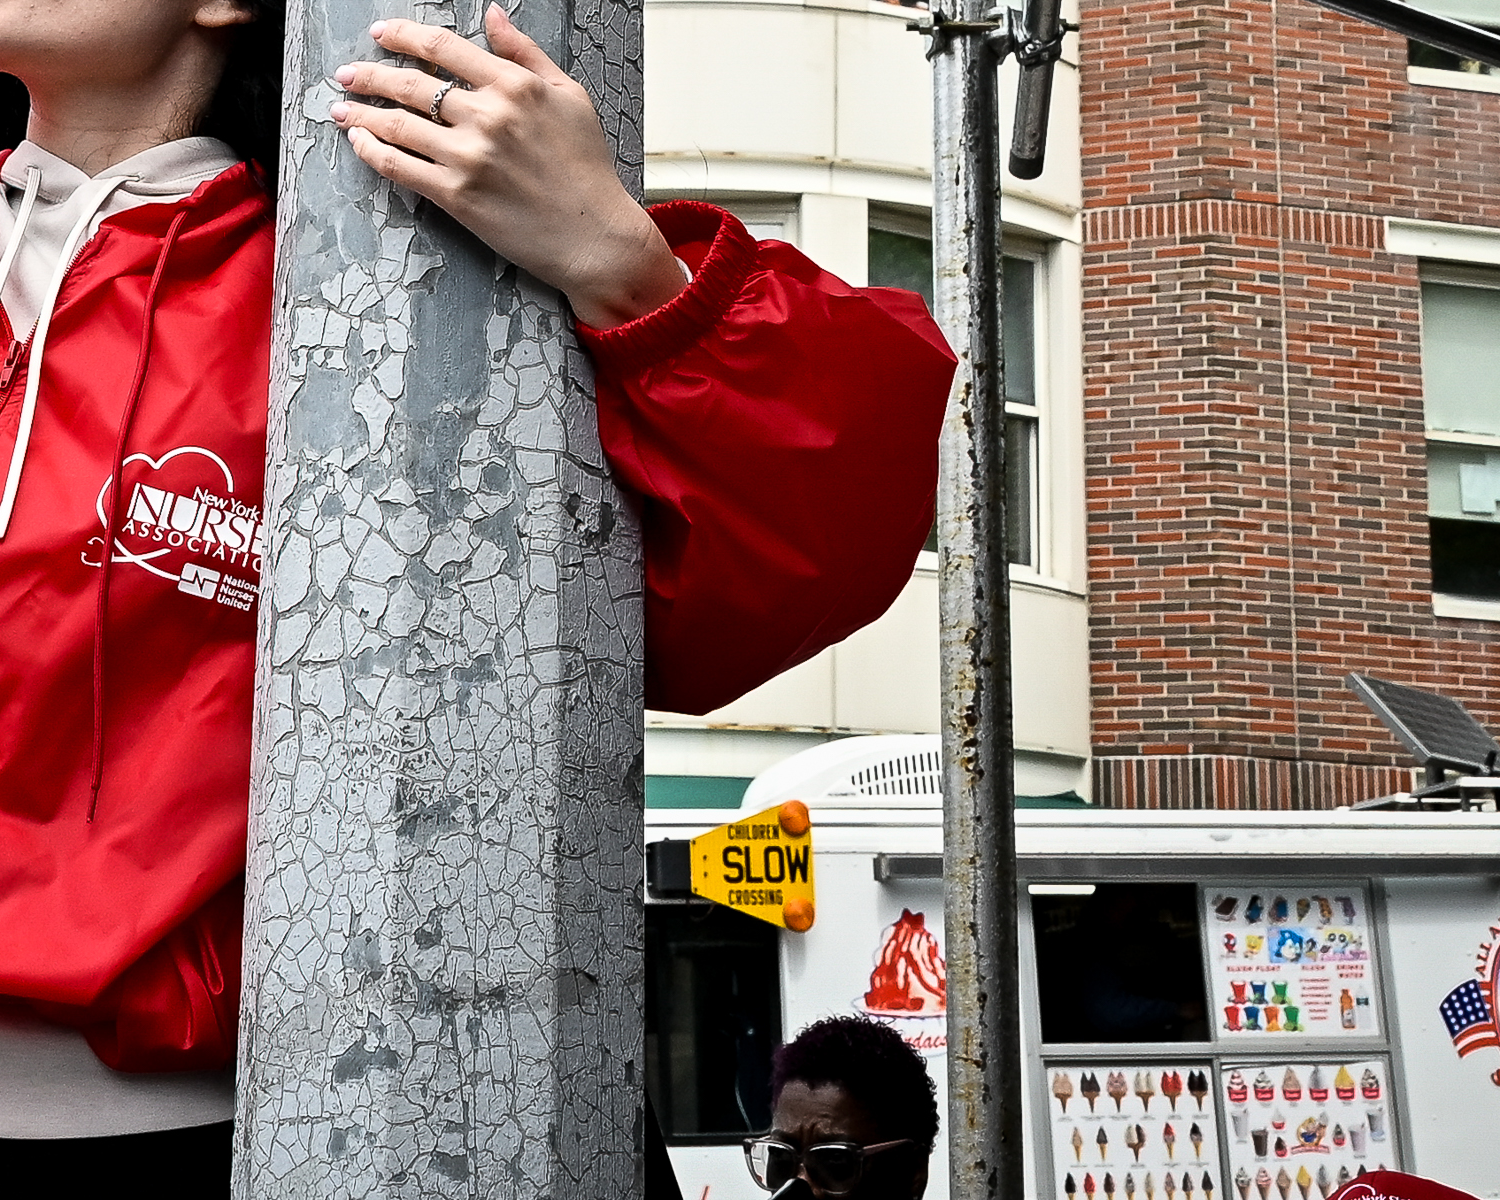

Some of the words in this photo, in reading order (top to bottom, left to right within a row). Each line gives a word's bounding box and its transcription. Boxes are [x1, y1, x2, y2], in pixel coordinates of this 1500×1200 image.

[192, 486, 228, 509] New
[231, 497, 260, 521] York
[217, 593, 251, 611] United
[220, 584, 255, 602] Nurses
[727, 824, 780, 840] CHILDREN
[722, 845, 809, 884] SLOW
[728, 889, 783, 906] CROSSING
